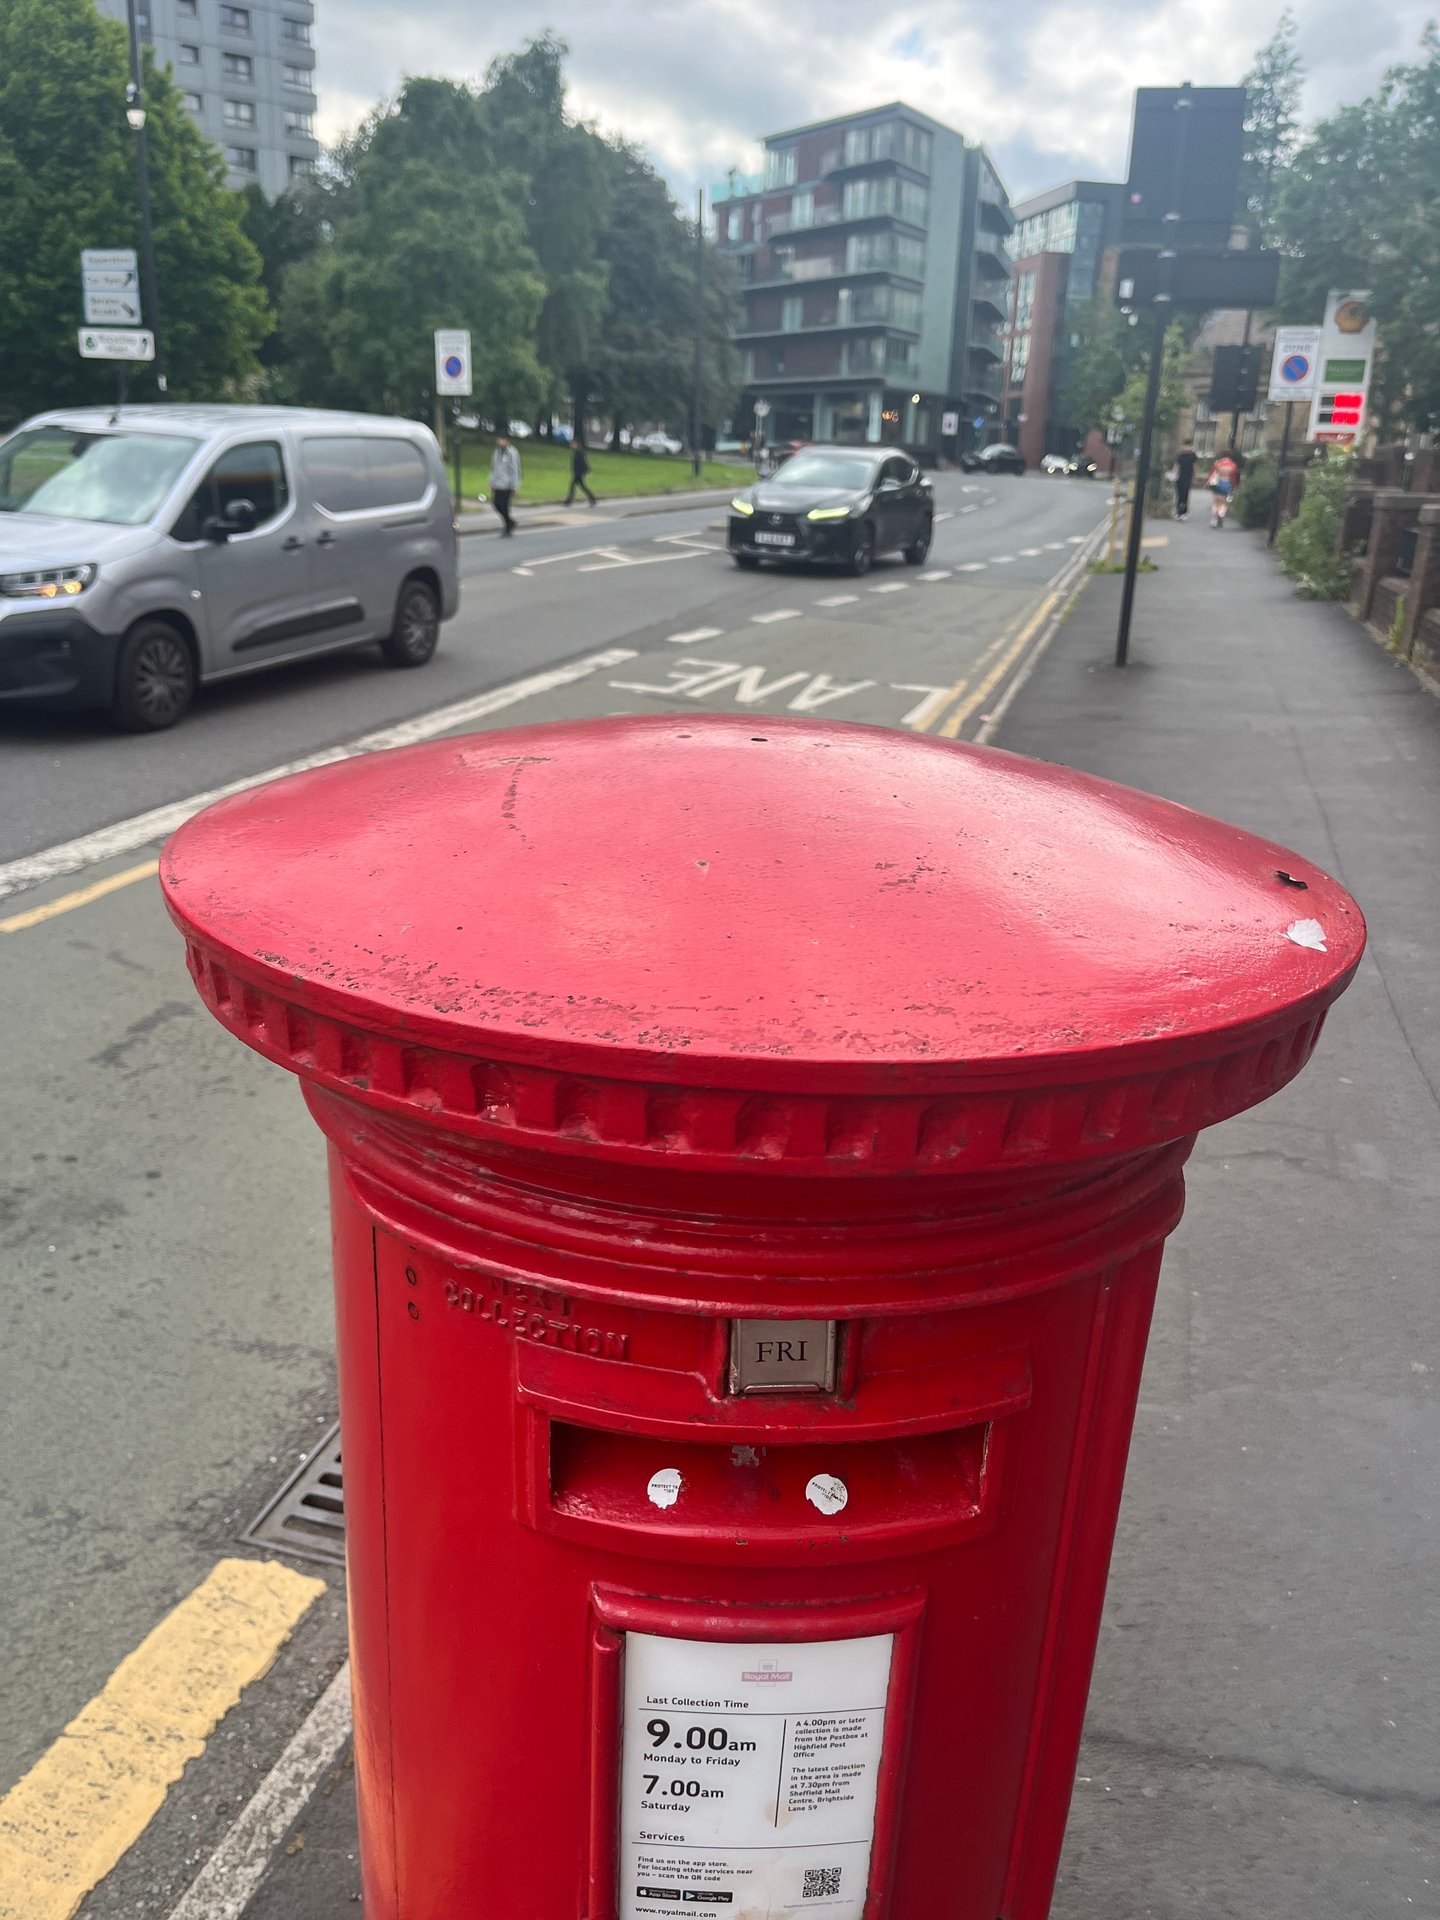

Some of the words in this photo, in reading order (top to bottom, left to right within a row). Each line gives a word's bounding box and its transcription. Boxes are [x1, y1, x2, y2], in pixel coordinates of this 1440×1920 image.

[608, 658, 952, 725] LANE
[444, 1279, 629, 1360] COLLECTION
[755, 1340, 808, 1363] FRI
[744, 1673, 769, 1681] Royal
[647, 1696, 668, 1705] Last
[671, 1697, 721, 1707] Collection
[724, 1700, 749, 1708] Time
[803, 1719, 836, 1727] 4.00pm
[647, 1718, 757, 1751] 9.00am
[795, 1727, 831, 1735] collection
[841, 1725, 862, 1733] made
[830, 1733, 859, 1741] Postbox
[793, 1743, 828, 1751] Highfield
[643, 1752, 687, 1765] Monday
[691, 1756, 702, 1764] to
[706, 1756, 741, 1767] Friday
[830, 1763, 866, 1771] collection
[642, 1774, 724, 1798] 7.00am
[800, 1781, 830, 1789] 7.30pm
[789, 1789, 823, 1797] Sheffield
[817, 1795, 855, 1803] Brightside
[641, 1800, 691, 1812] Saturday
[639, 1830, 685, 1842] Services
[651, 1864, 681, 1873] locating
[635, 1906, 717, 1918] www.royalmail.com
